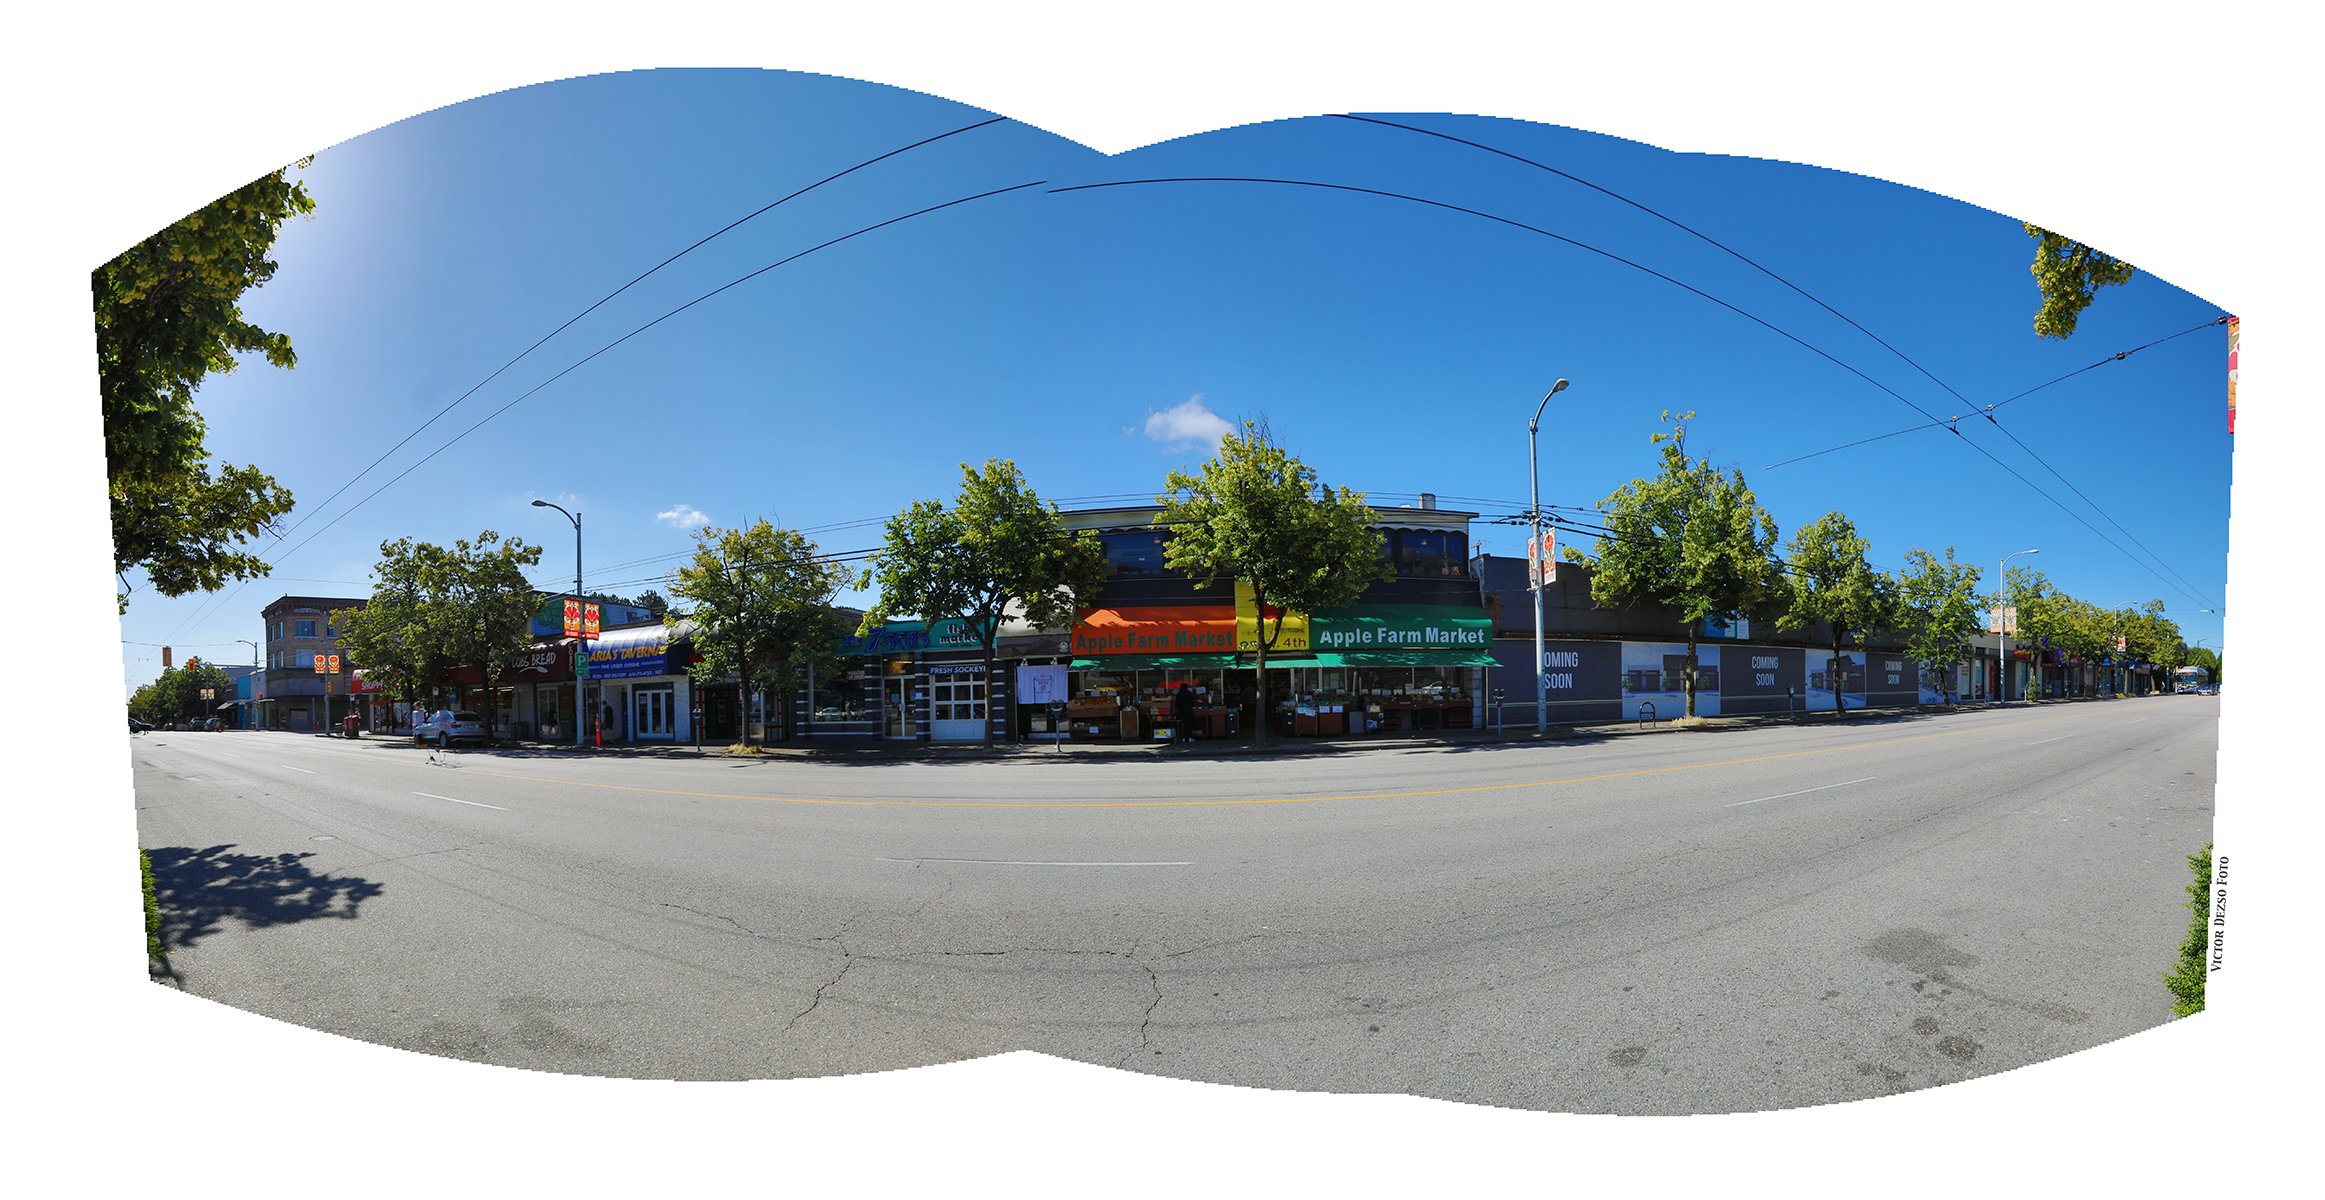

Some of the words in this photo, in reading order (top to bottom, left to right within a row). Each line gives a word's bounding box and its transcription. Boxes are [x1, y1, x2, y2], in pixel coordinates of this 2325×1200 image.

[865, 626, 885, 652] 7
[1076, 633, 1123, 652] Apple
[1128, 632, 1169, 648] Farm
[1175, 631, 1233, 647] Market
[1320, 628, 1372, 647] Apple
[1377, 627, 1422, 643] Farm
[1425, 627, 1484, 643] Market
[532, 652, 557, 666] BREAD
[578, 656, 586, 667] P
[1544, 652, 1579, 668] OMING
[1751, 656, 1779, 669] COMING
[1545, 673, 1573, 689] SOON
[1755, 673, 1775, 686] SOON
